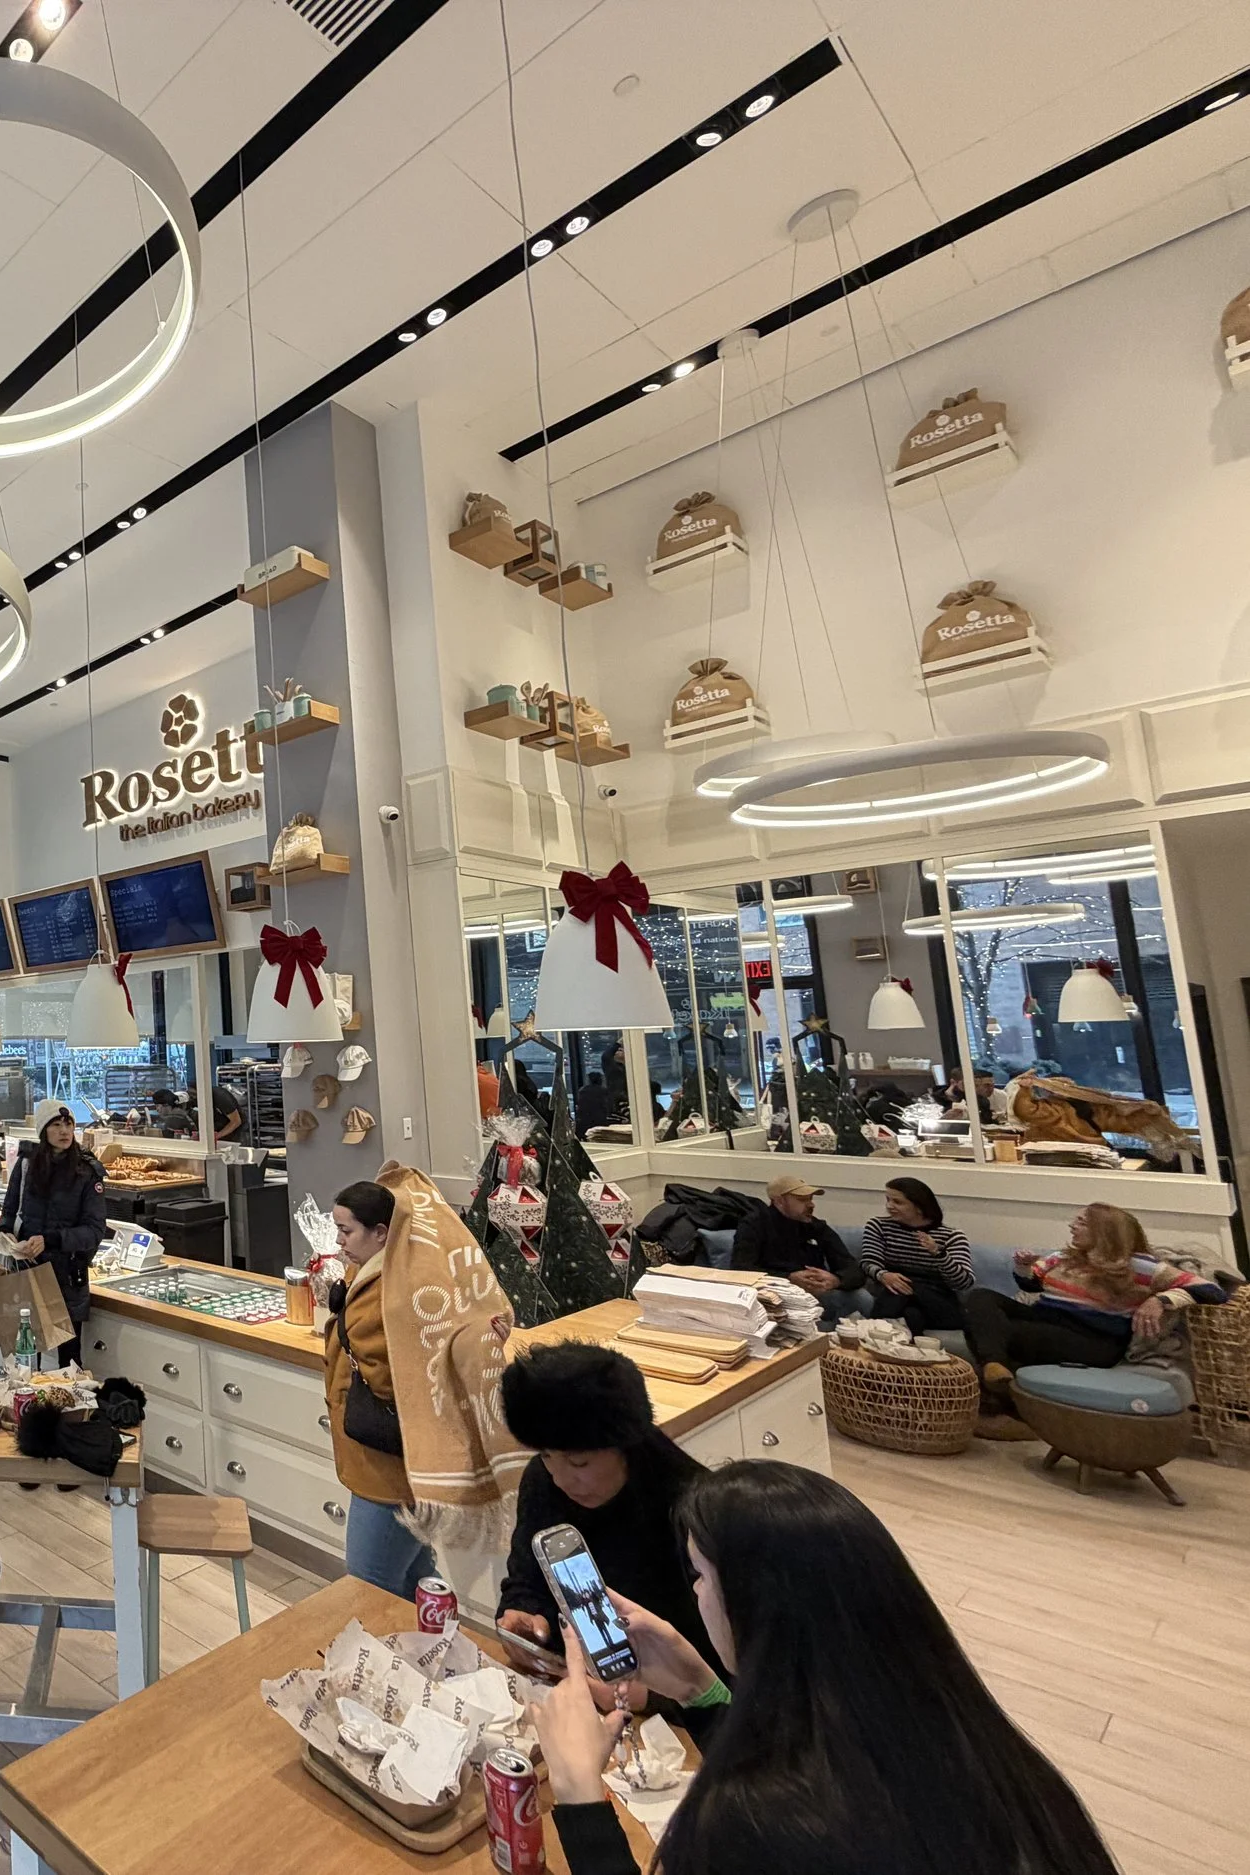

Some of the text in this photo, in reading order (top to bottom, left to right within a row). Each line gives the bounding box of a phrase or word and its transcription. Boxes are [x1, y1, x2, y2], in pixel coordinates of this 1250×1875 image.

[910, 412, 984, 449] Rosetta
[937, 614, 1015, 641] Rosetta
[676, 688, 731, 711] Rosetta
[81, 720, 265, 827] Rosett
[119, 824, 146, 842] the
[419, 1600, 455, 1627] Coca
[417, 1637, 453, 1668] Rosetta
[351, 1647, 370, 1692] Rosetta
